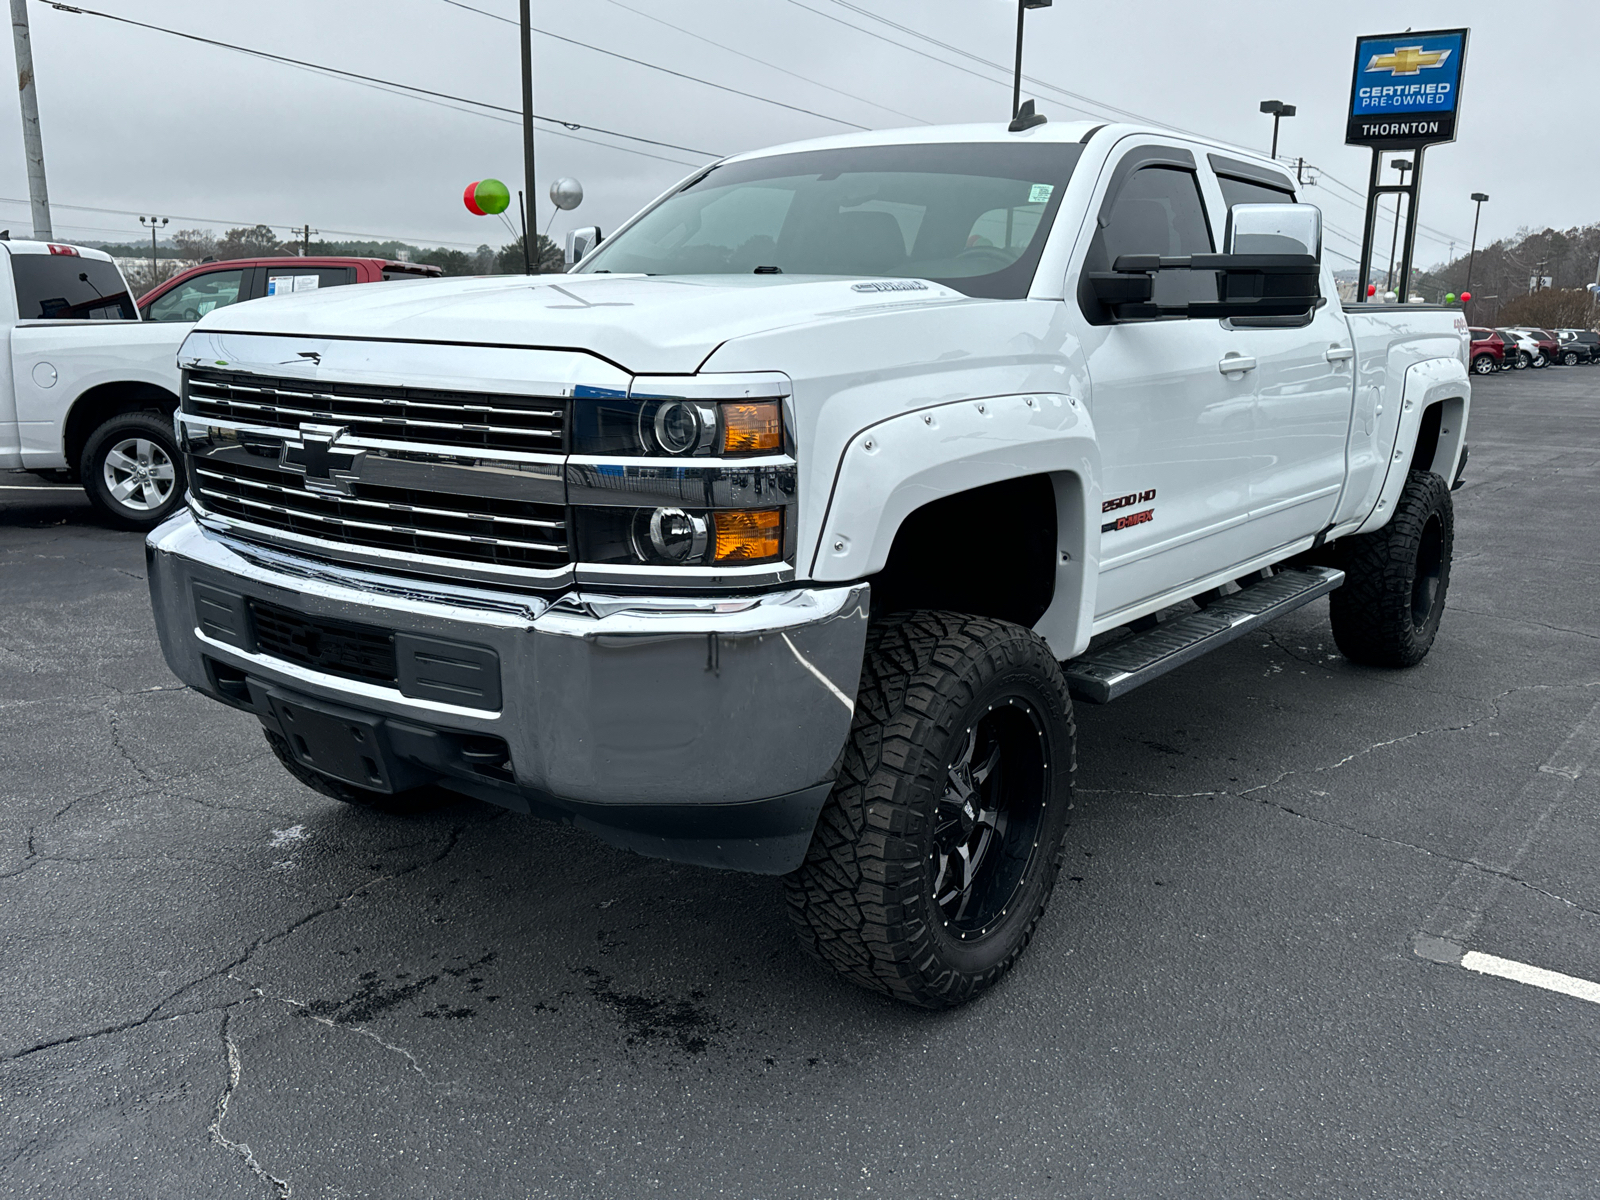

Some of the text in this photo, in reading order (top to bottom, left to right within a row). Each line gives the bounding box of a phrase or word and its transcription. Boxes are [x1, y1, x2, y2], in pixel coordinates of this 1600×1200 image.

[1359, 83, 1450, 98] CERTIFIED
[1362, 94, 1445, 107] PRE-OWNED
[1362, 121, 1439, 136] THORNTON
[1102, 489, 1156, 513] 2500 HD
[1115, 508, 1155, 531] D-MAX
